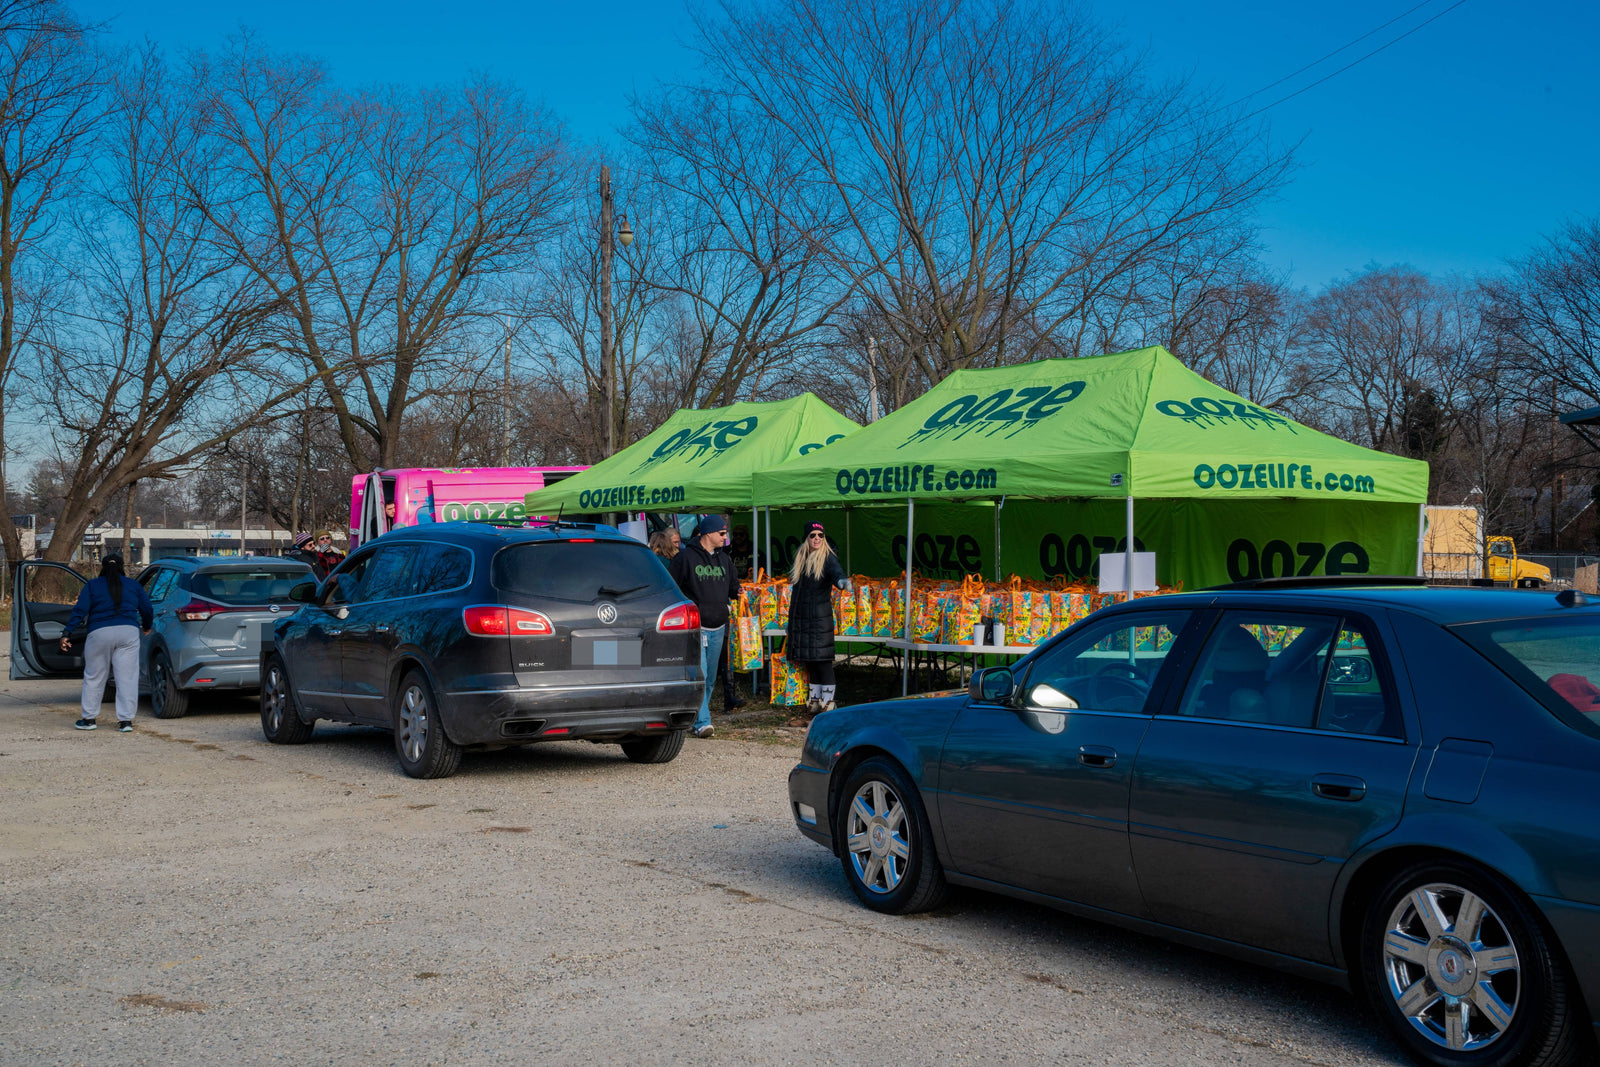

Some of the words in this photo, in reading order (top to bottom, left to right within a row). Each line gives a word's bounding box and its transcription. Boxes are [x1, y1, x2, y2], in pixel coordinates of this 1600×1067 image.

[924, 381, 1086, 430] ooze
[836, 465, 997, 495] OOZELIFE.com
[1194, 463, 1375, 493] OOZELIFE.com
[579, 485, 685, 509] OOZELIFE.com
[442, 502, 527, 525] ooze
[1226, 538, 1370, 583] ooze
